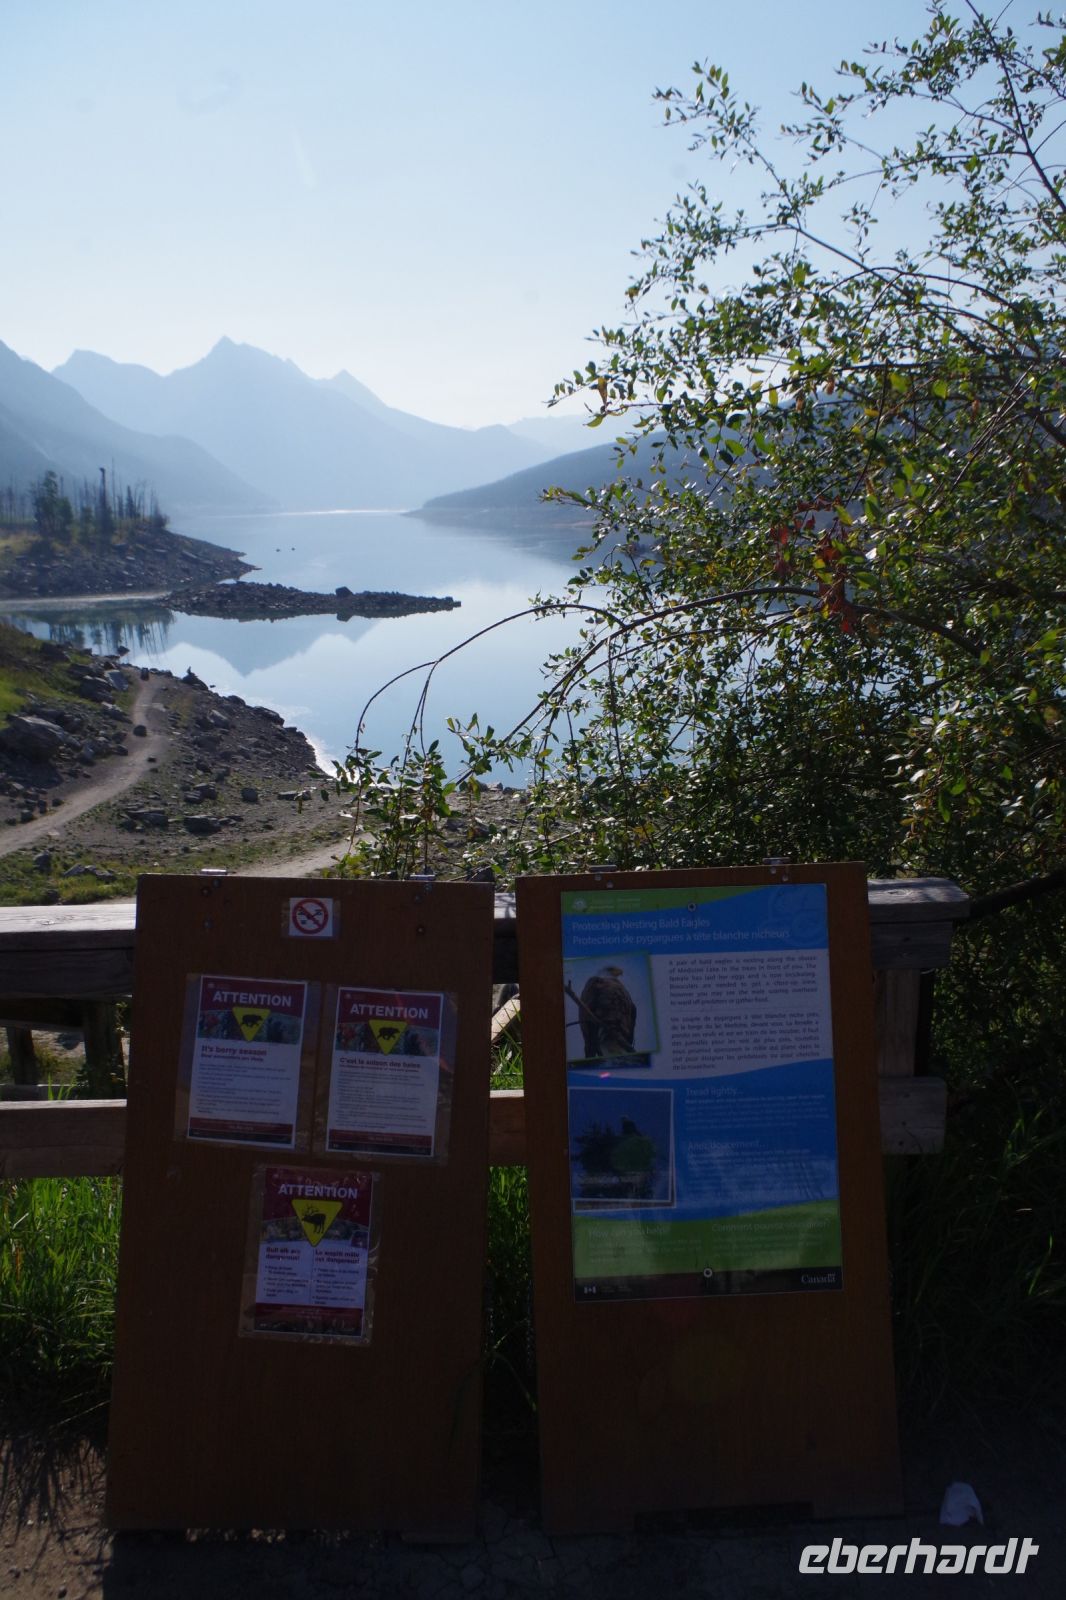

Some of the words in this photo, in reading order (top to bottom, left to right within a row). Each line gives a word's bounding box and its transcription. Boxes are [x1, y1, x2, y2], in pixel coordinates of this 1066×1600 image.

[572, 919, 621, 931] Protecting
[622, 918, 657, 930] Nesting
[658, 916, 680, 928] Bald
[681, 916, 711, 929] Eagles
[572, 935, 621, 945] Protection
[622, 934, 634, 943] de
[636, 934, 684, 945] pygargues
[713, 929, 750, 940] blanche
[213, 991, 292, 1007] ATTENTION
[350, 1003, 429, 1019] ATTENTION
[216, 1046, 237, 1055] berry
[239, 1048, 267, 1056] season
[278, 1183, 358, 1199] ATTENTION
